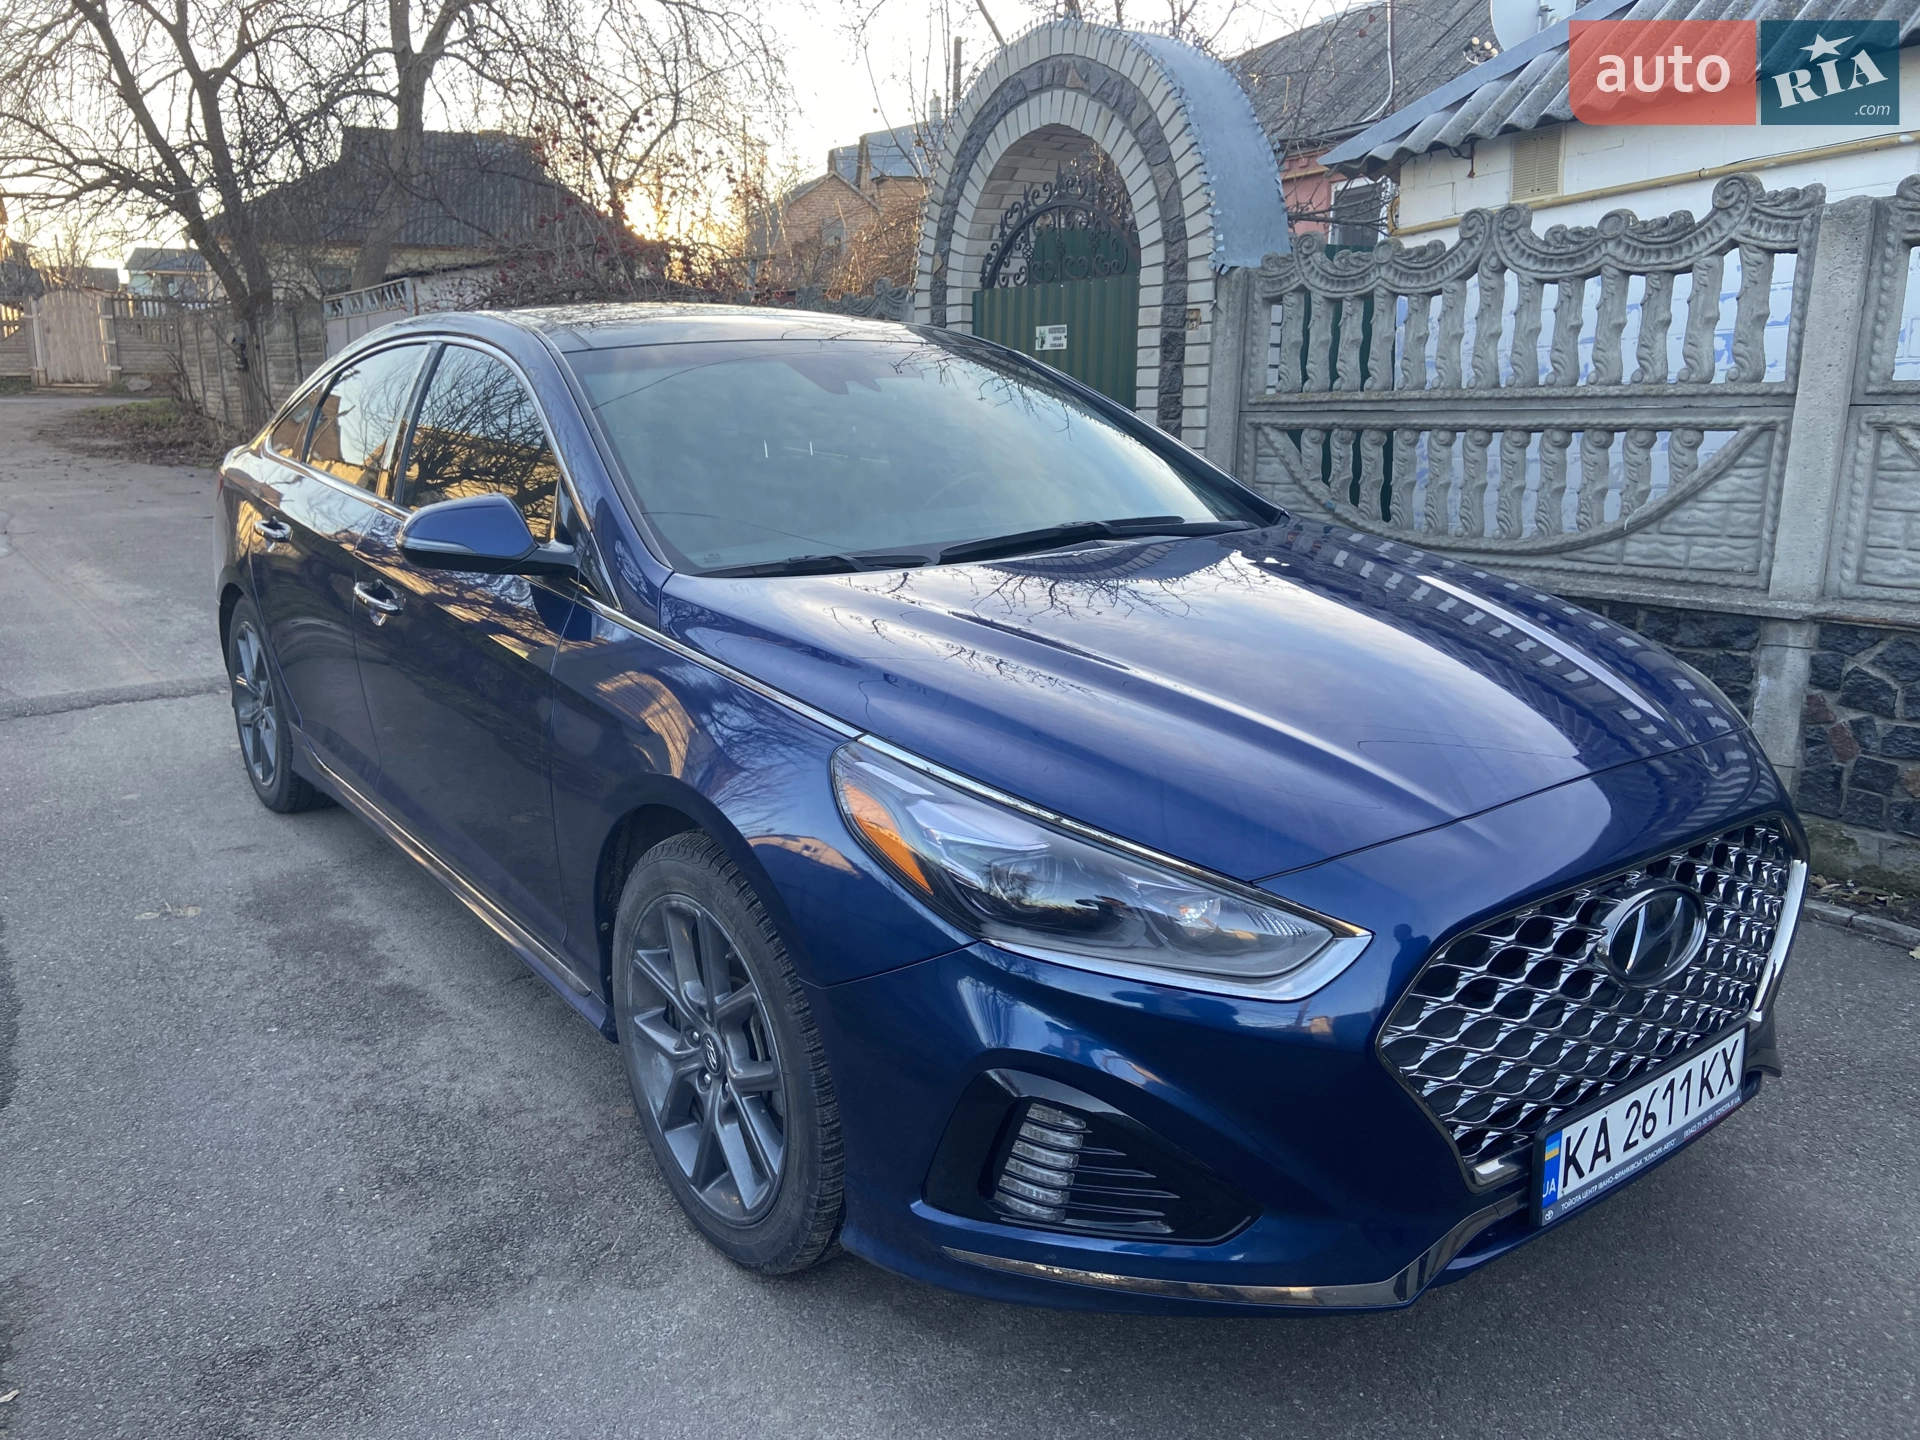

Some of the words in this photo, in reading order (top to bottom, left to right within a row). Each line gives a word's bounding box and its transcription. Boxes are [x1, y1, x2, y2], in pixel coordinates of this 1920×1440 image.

[1562, 1116, 1612, 1189] KA
[1622, 1068, 1692, 1153] 2611
[1697, 1039, 1739, 1108] KX
